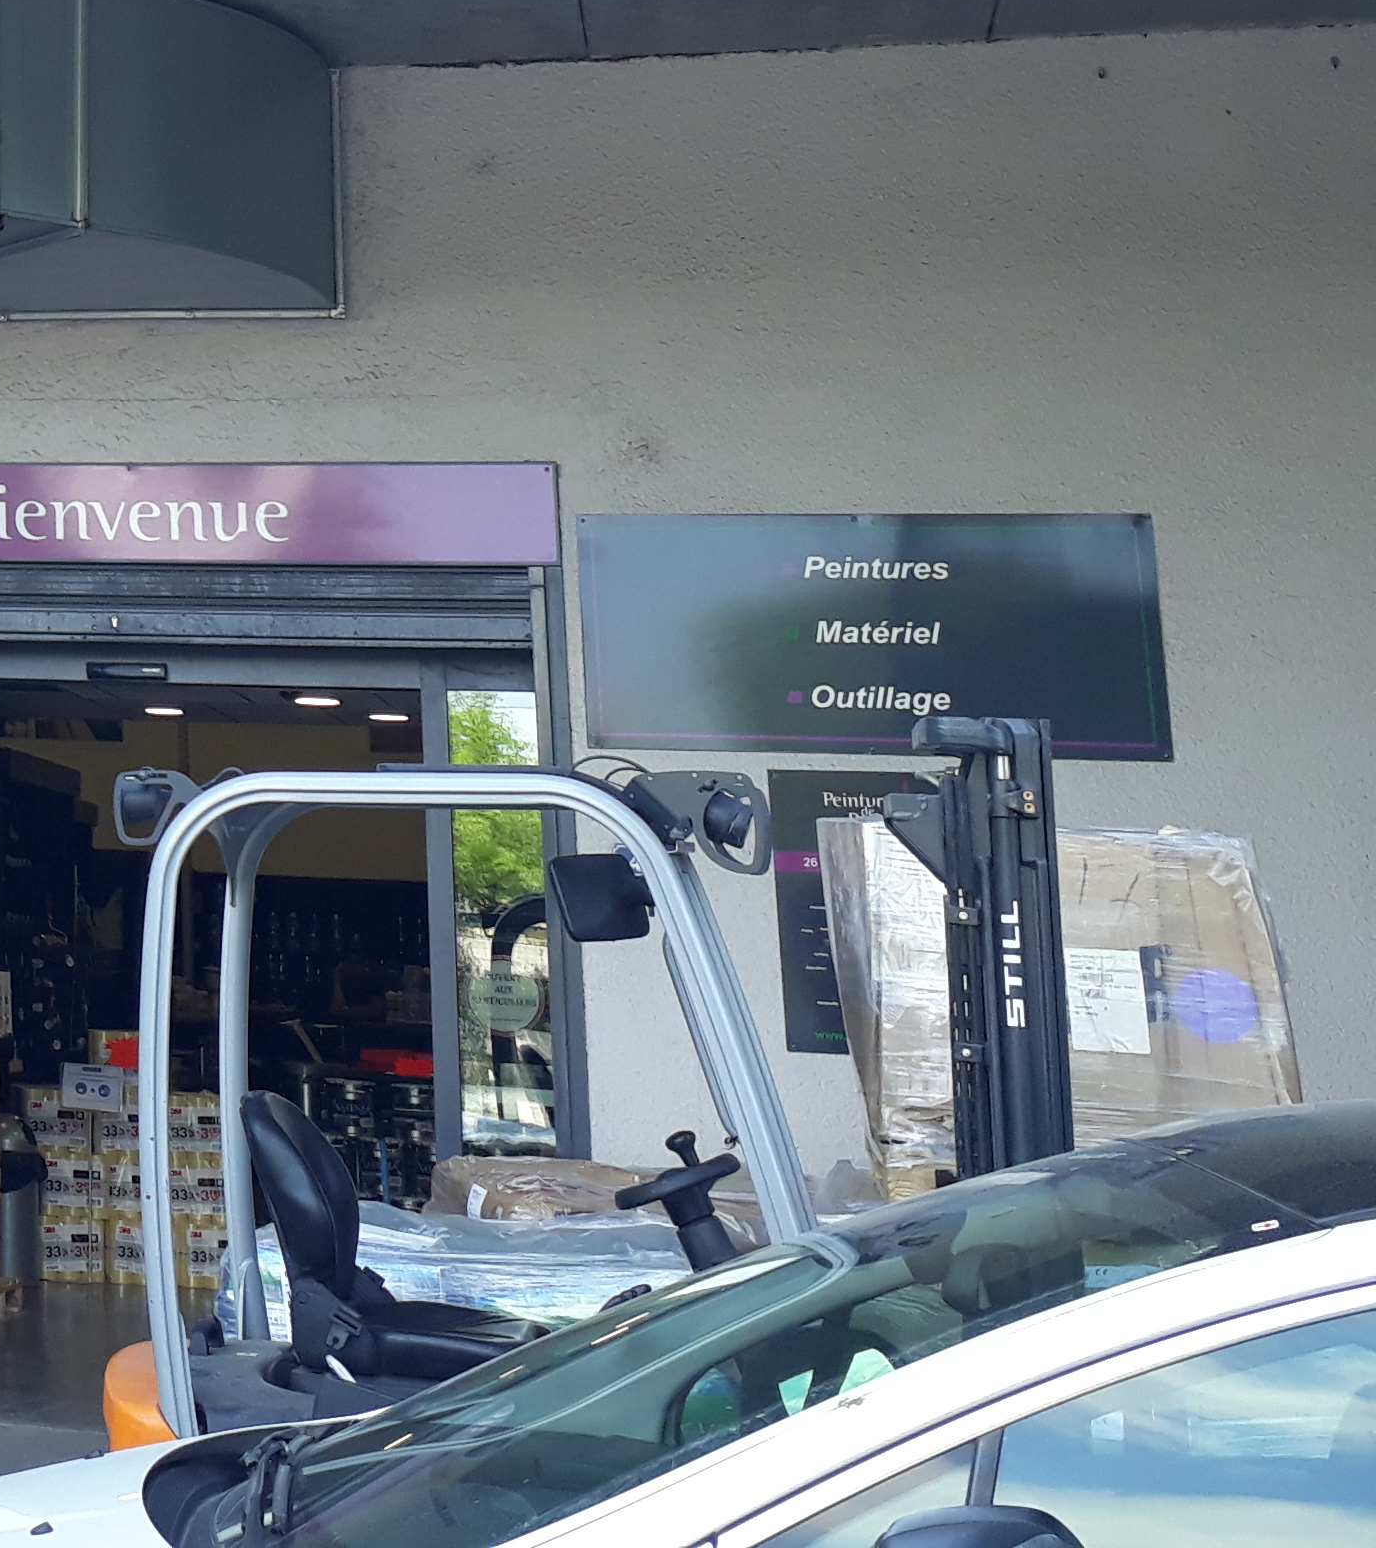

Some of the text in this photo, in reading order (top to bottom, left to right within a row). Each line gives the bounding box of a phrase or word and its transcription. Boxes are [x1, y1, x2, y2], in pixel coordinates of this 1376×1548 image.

[804, 555, 950, 581] Peintures
[814, 620, 943, 646] Matériel
[810, 684, 952, 716] Outillage
[822, 791, 884, 808] Peintur
[1000, 900, 1026, 1028] STILL
